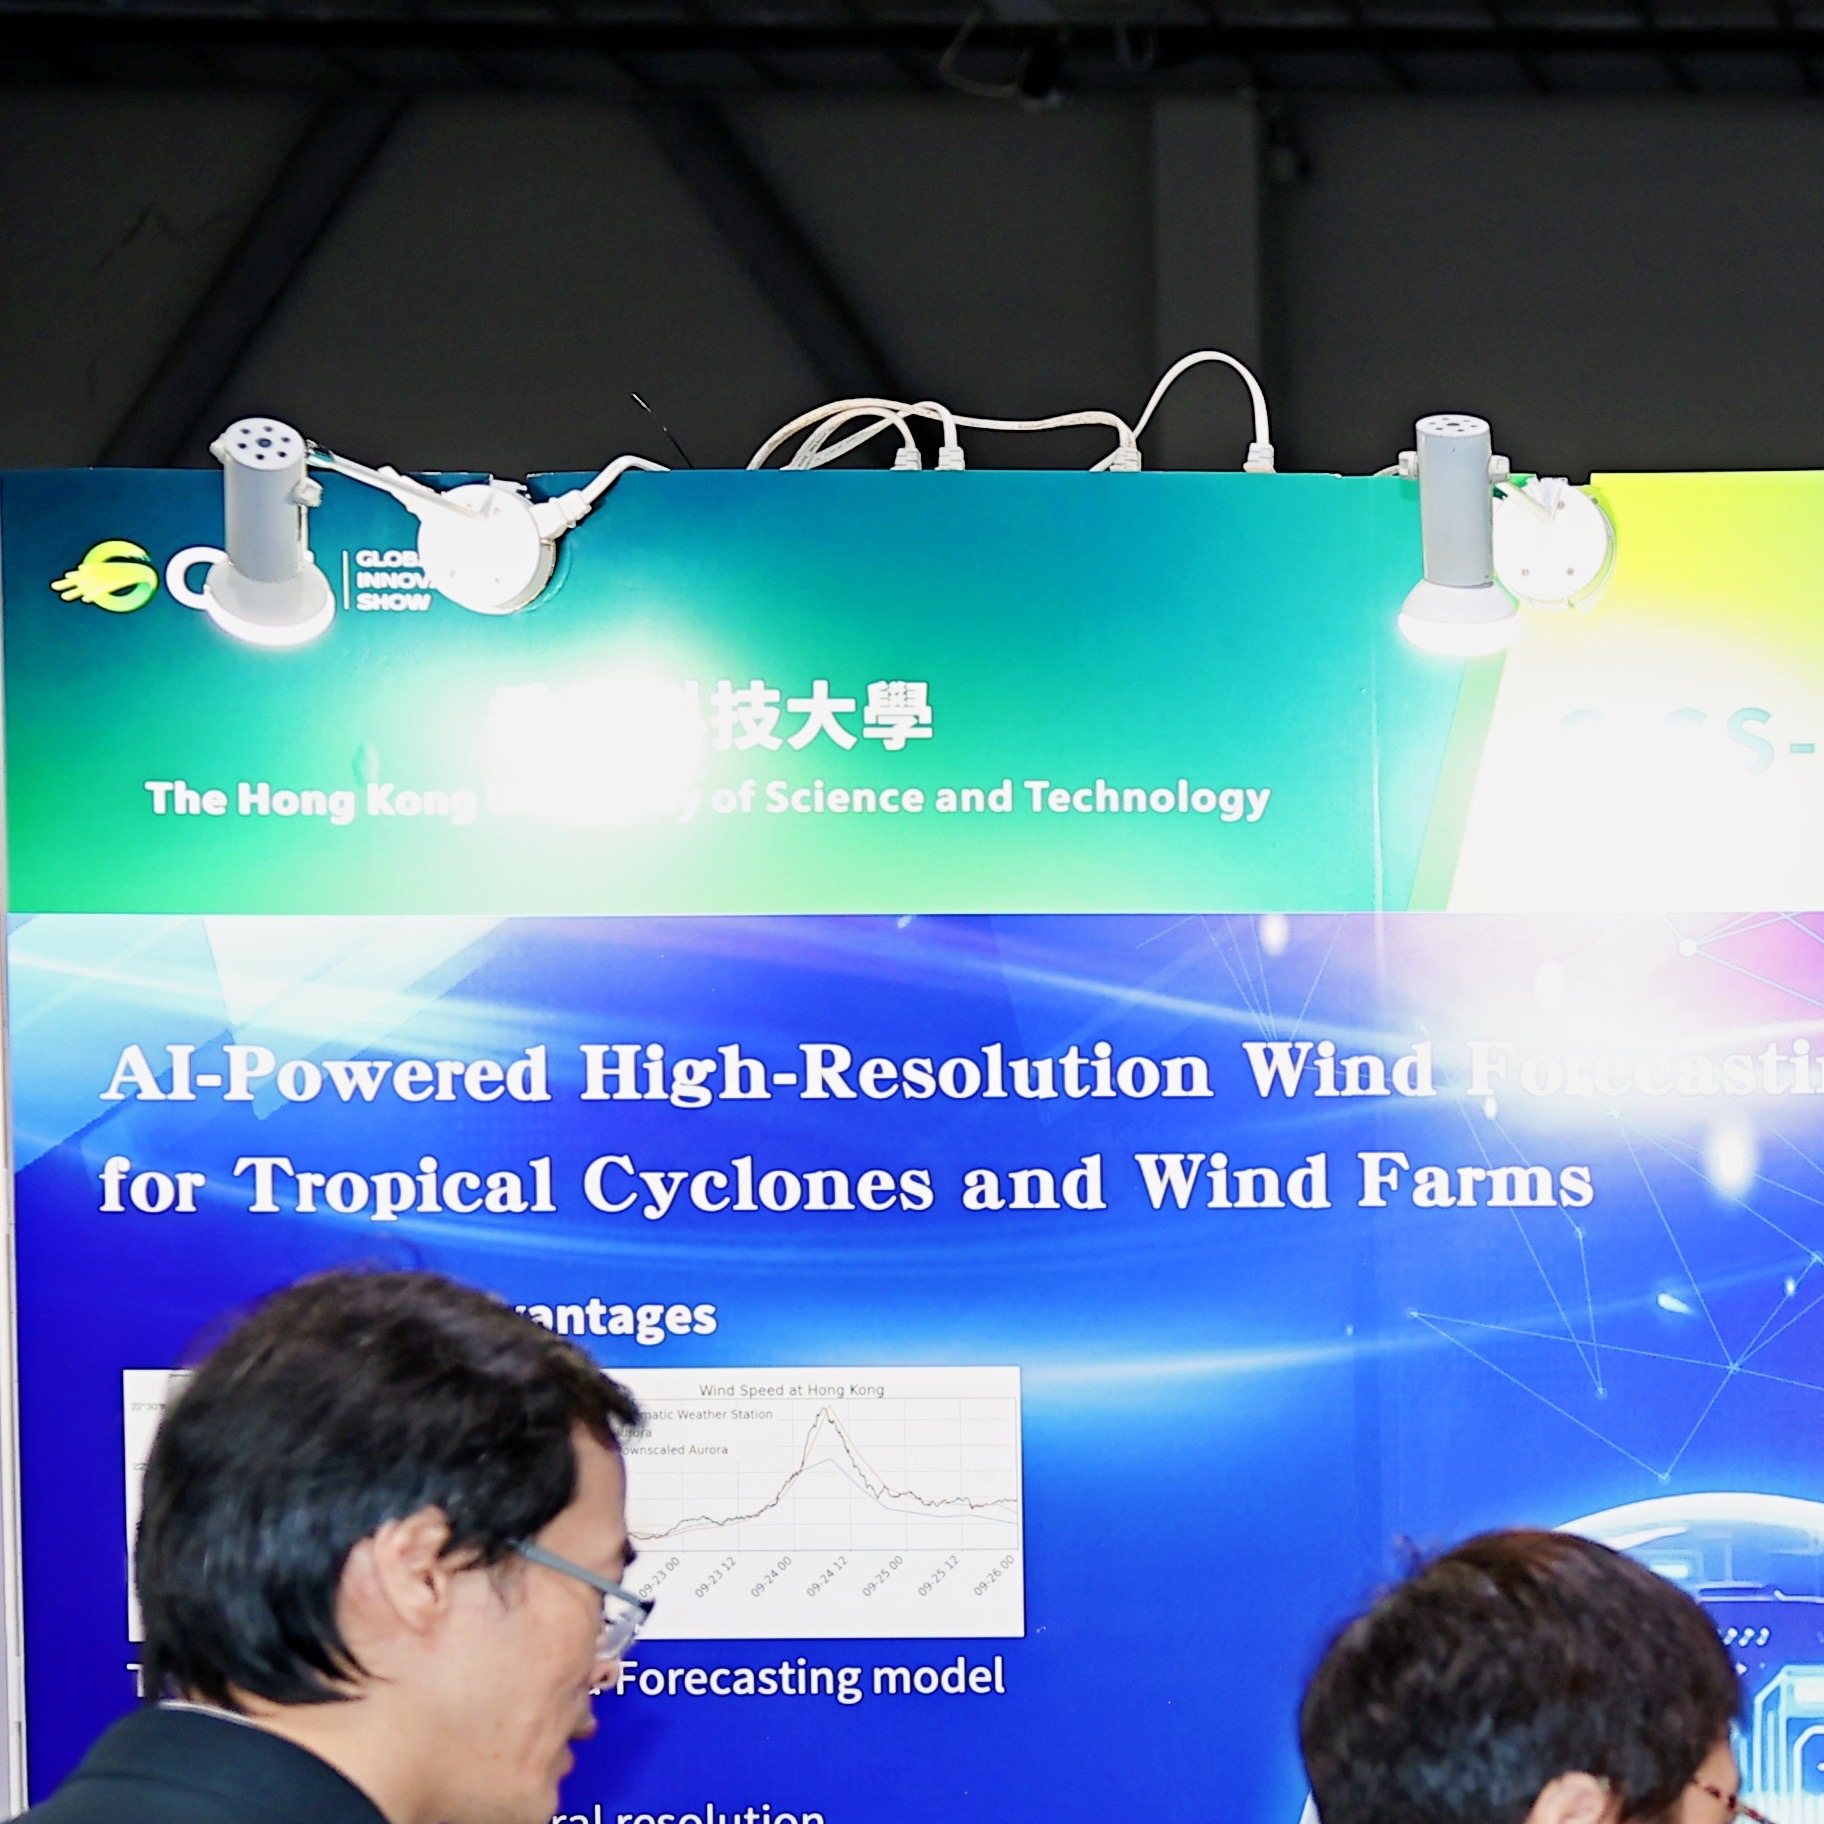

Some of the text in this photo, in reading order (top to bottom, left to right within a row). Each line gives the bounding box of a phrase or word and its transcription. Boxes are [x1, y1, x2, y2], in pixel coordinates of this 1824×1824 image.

[356, 593, 432, 611] SHOW
[144, 779, 229, 815] The
[237, 781, 356, 826] Hong
[366, 781, 478, 826] Kong
[711, 779, 757, 813] of
[765, 779, 925, 814] Science
[935, 780, 1012, 813] and
[1024, 779, 1272, 823] Technology
[99, 1043, 551, 1103] AI-Powered
[580, 1042, 1214, 1108] High-Resolution
[1243, 1041, 1436, 1099] Wind
[99, 1153, 1595, 1222] for Tropical Cyclones and Wind Farms
[515, 1298, 718, 1346] antages
[699, 1383, 886, 1400] Wind Speed at Hong Kong
[677, 1408, 727, 1420] Weather
[730, 1408, 774, 1420] Station
[688, 1444, 729, 1456] Aurora
[638, 1556, 681, 1599] 09-23 00
[694, 1556, 737, 1599] 09-23 12
[750, 1555, 793, 1598] 09-24 00
[806, 1555, 849, 1598] 09-24 12
[862, 1555, 904, 1597] 09-25 00
[917, 1554, 960, 1597] 09-25 12
[973, 1554, 1015, 1596] 09-26 00
[617, 1656, 1005, 1704] Forecasting model
